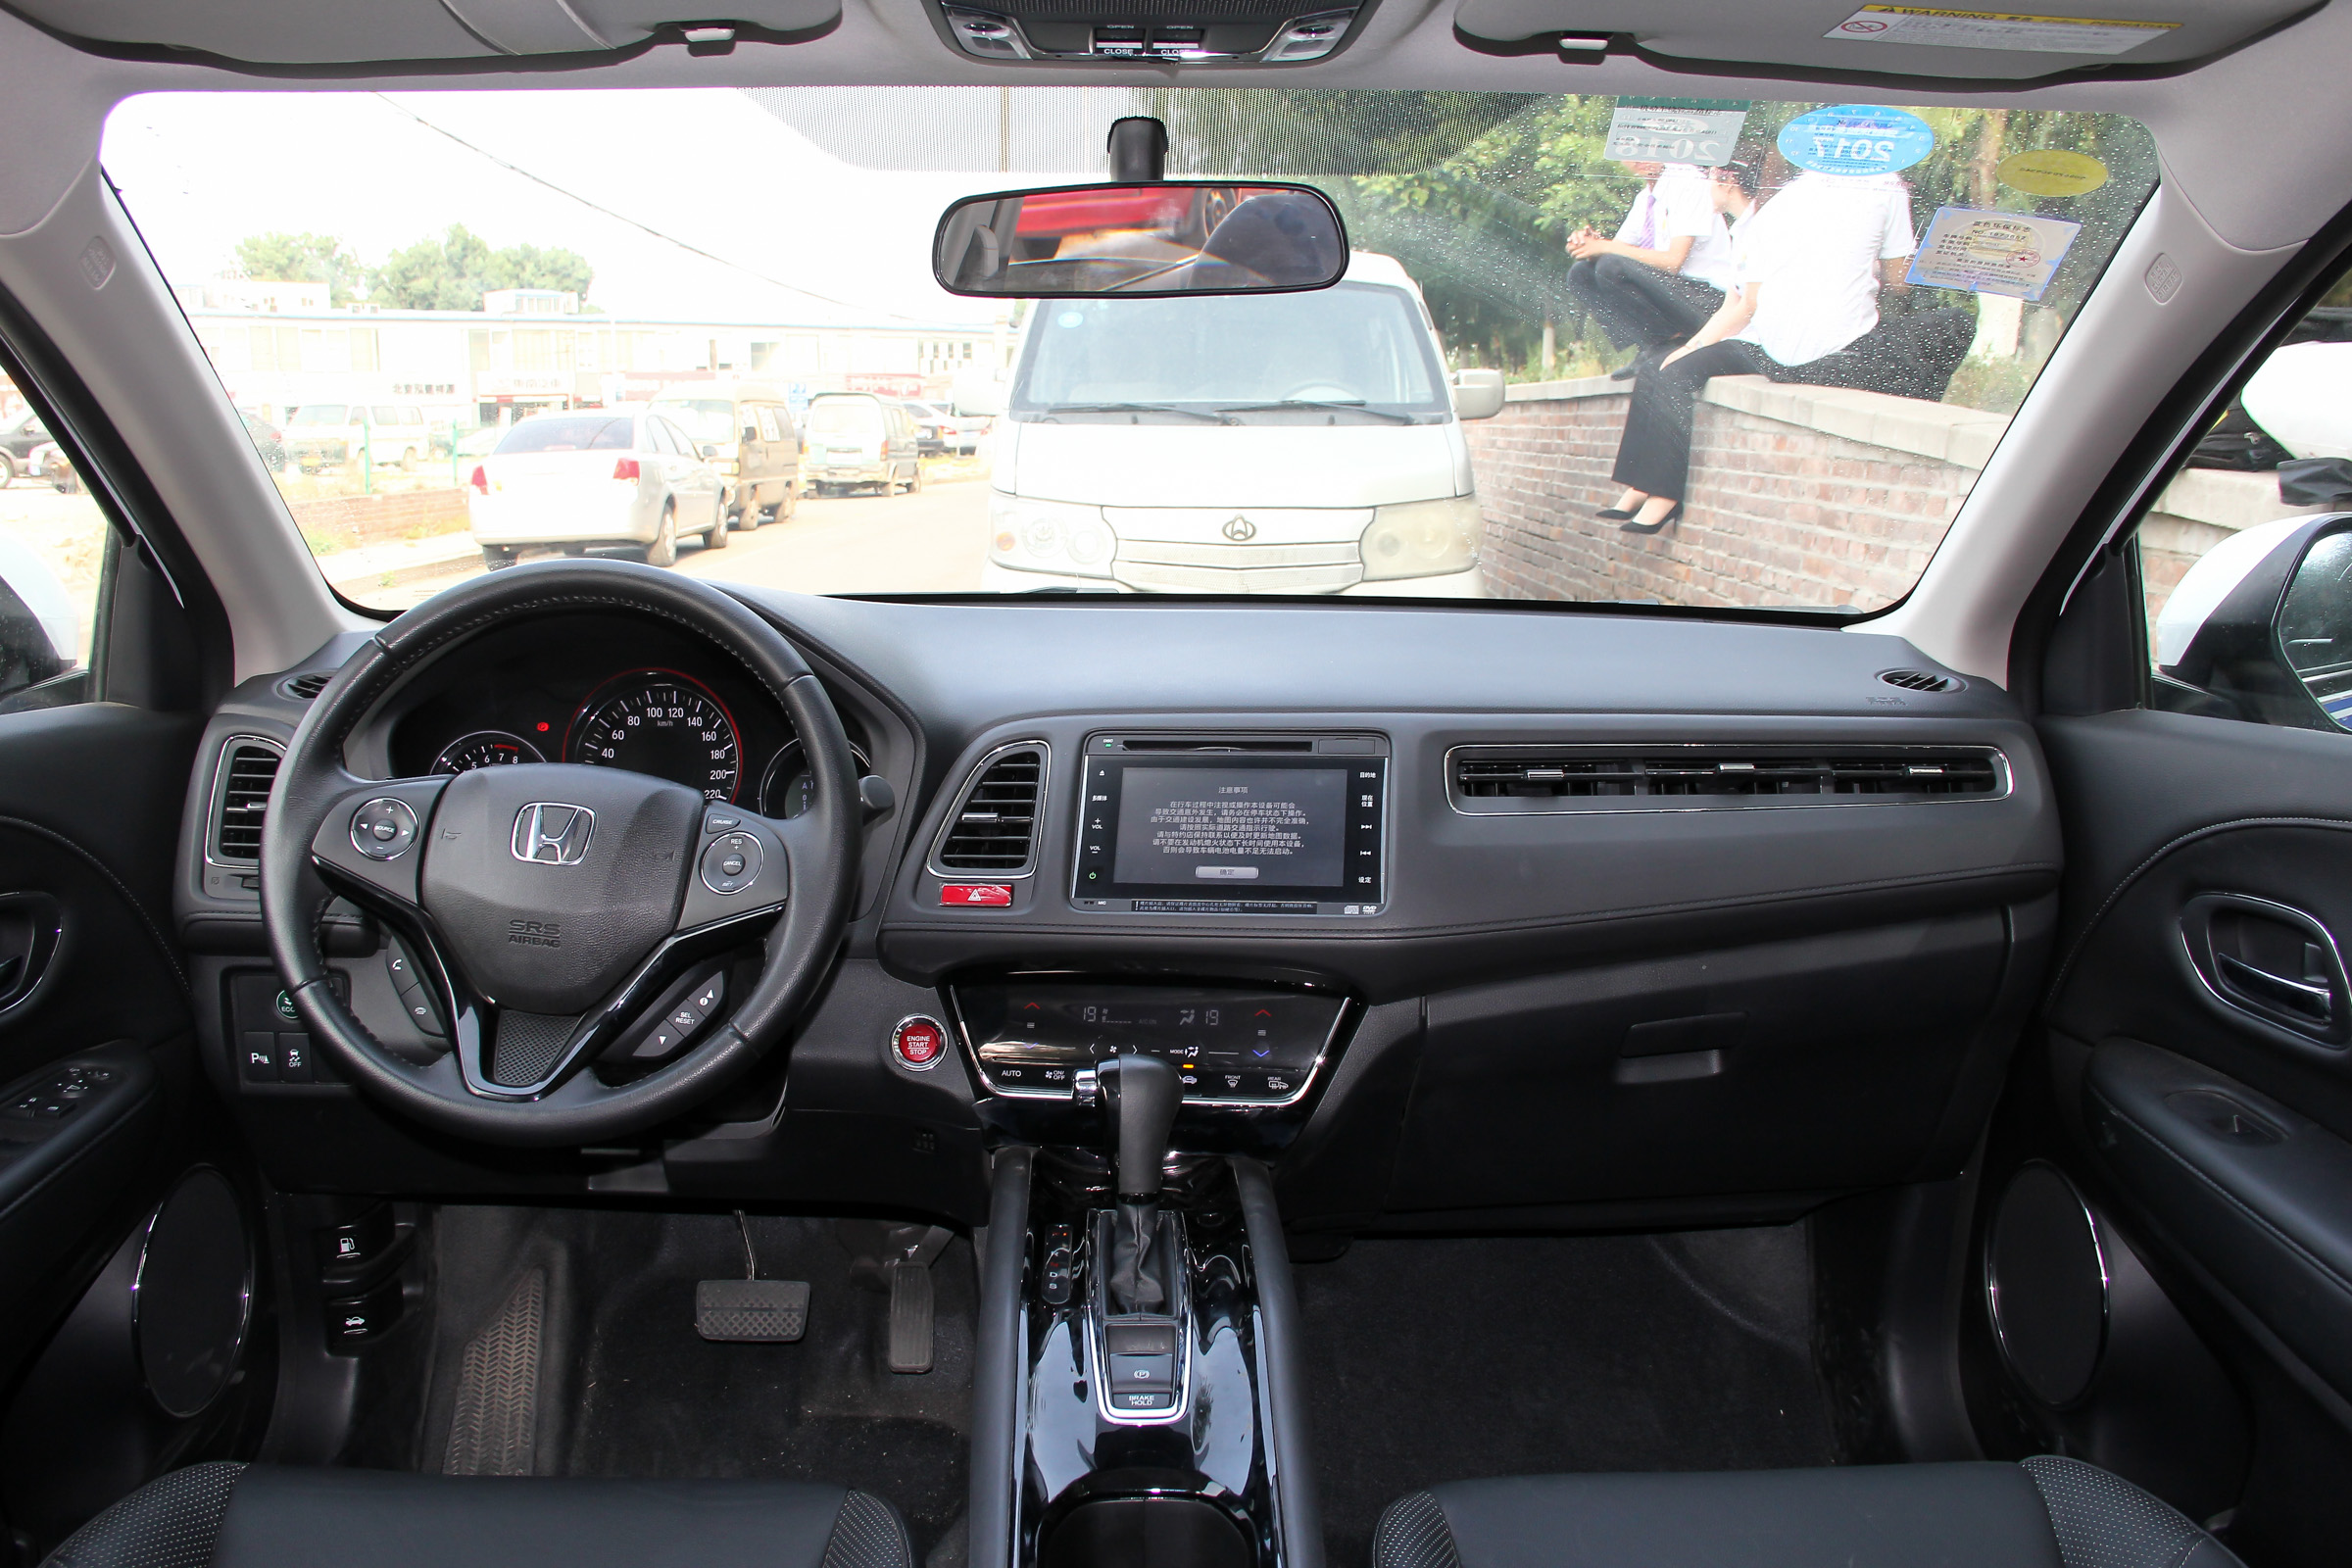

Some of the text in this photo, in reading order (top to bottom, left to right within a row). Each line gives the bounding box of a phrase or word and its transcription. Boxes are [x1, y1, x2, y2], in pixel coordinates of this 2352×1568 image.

[1902, 8, 1997, 21] WARNING
[647, 708, 662, 717] 100
[668, 708, 684, 718] 120
[627, 716, 640, 726] 80
[687, 717, 703, 727] 140
[612, 730, 625, 740] 60
[702, 731, 716, 741] 160
[601, 748, 614, 759] 40
[710, 750, 725, 760] 180
[484, 755, 490, 763] 6
[710, 770, 726, 780] 200
[705, 789, 720, 799] 220
[374, 825, 395, 834] SOURCE
[510, 919, 562, 936] SRS
[509, 934, 562, 948] AIRBAG
[1083, 1005, 1097, 1022] 19
[1205, 1008, 1219, 1025] 19
[1001, 1069, 1022, 1078] AUTO
